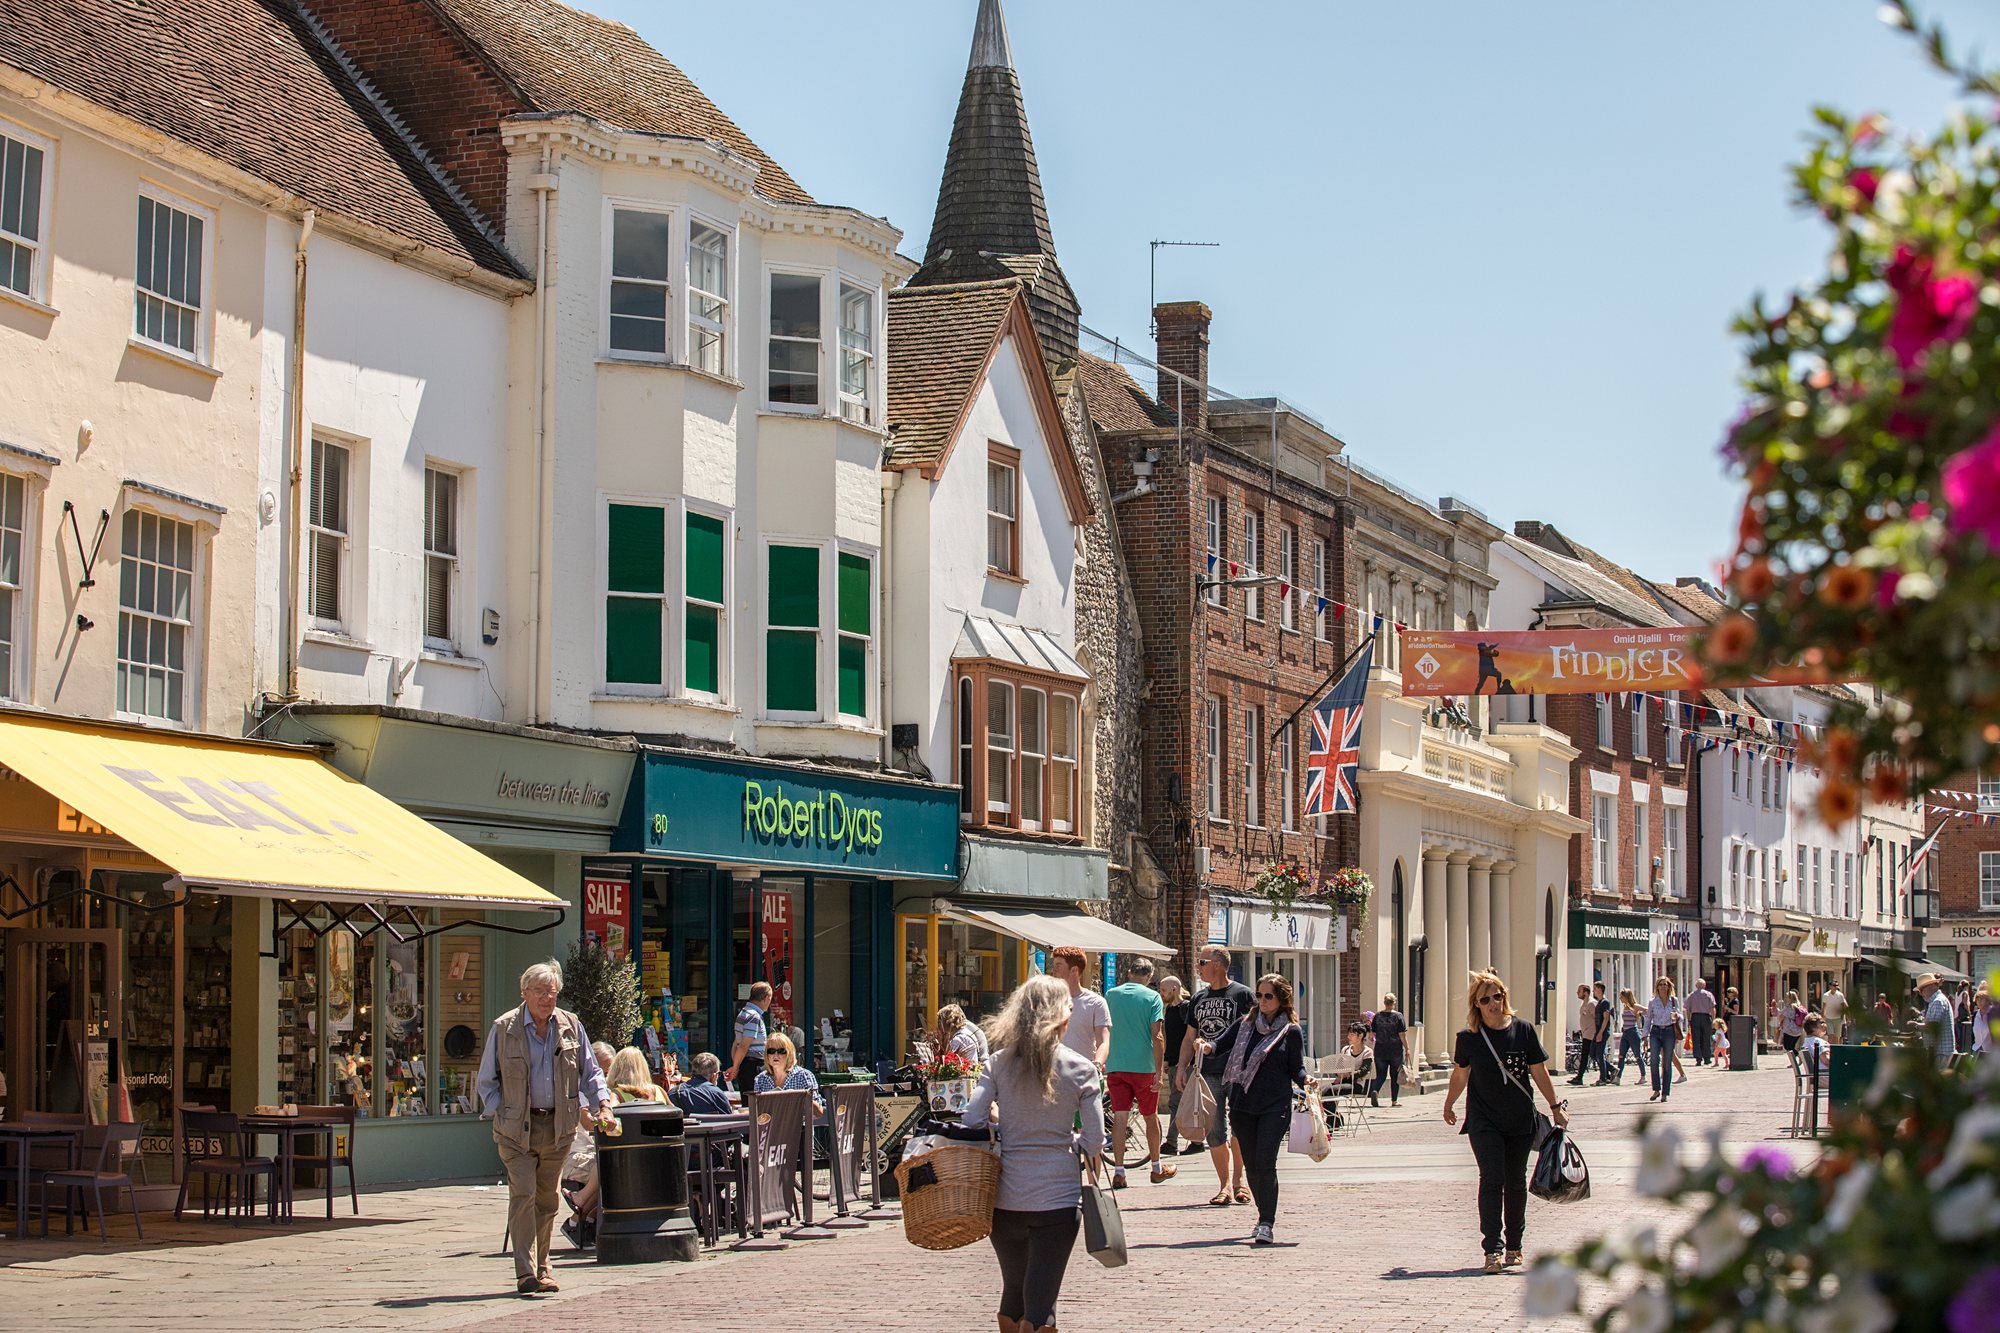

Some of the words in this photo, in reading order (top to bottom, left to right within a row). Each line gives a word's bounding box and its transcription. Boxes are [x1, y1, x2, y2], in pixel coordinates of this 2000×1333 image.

[1614, 634, 1635, 643] Omid
[1637, 633, 1661, 645] Djalili
[1549, 641, 1691, 683] FIDDLER
[101, 764, 358, 835] EAT.
[498, 772, 556, 801] between
[560, 779, 580, 805] the
[582, 783, 610, 809] lines
[58, 799, 114, 834] EA
[655, 814, 667, 833] 80
[746, 781, 826, 839] Robert
[829, 792, 882, 852] Dyas
[587, 883, 622, 916] SALE
[762, 894, 786, 923] ALE
[1590, 924, 1617, 938] MOUNTAIN
[1618, 927, 1649, 941] WAREHOUSE
[1952, 927, 1986, 937] HSBC
[1197, 1007, 1232, 1021] DYNASTY
[1205, 1000, 1225, 1009] DUCK
[768, 1144, 787, 1168] EAT.
